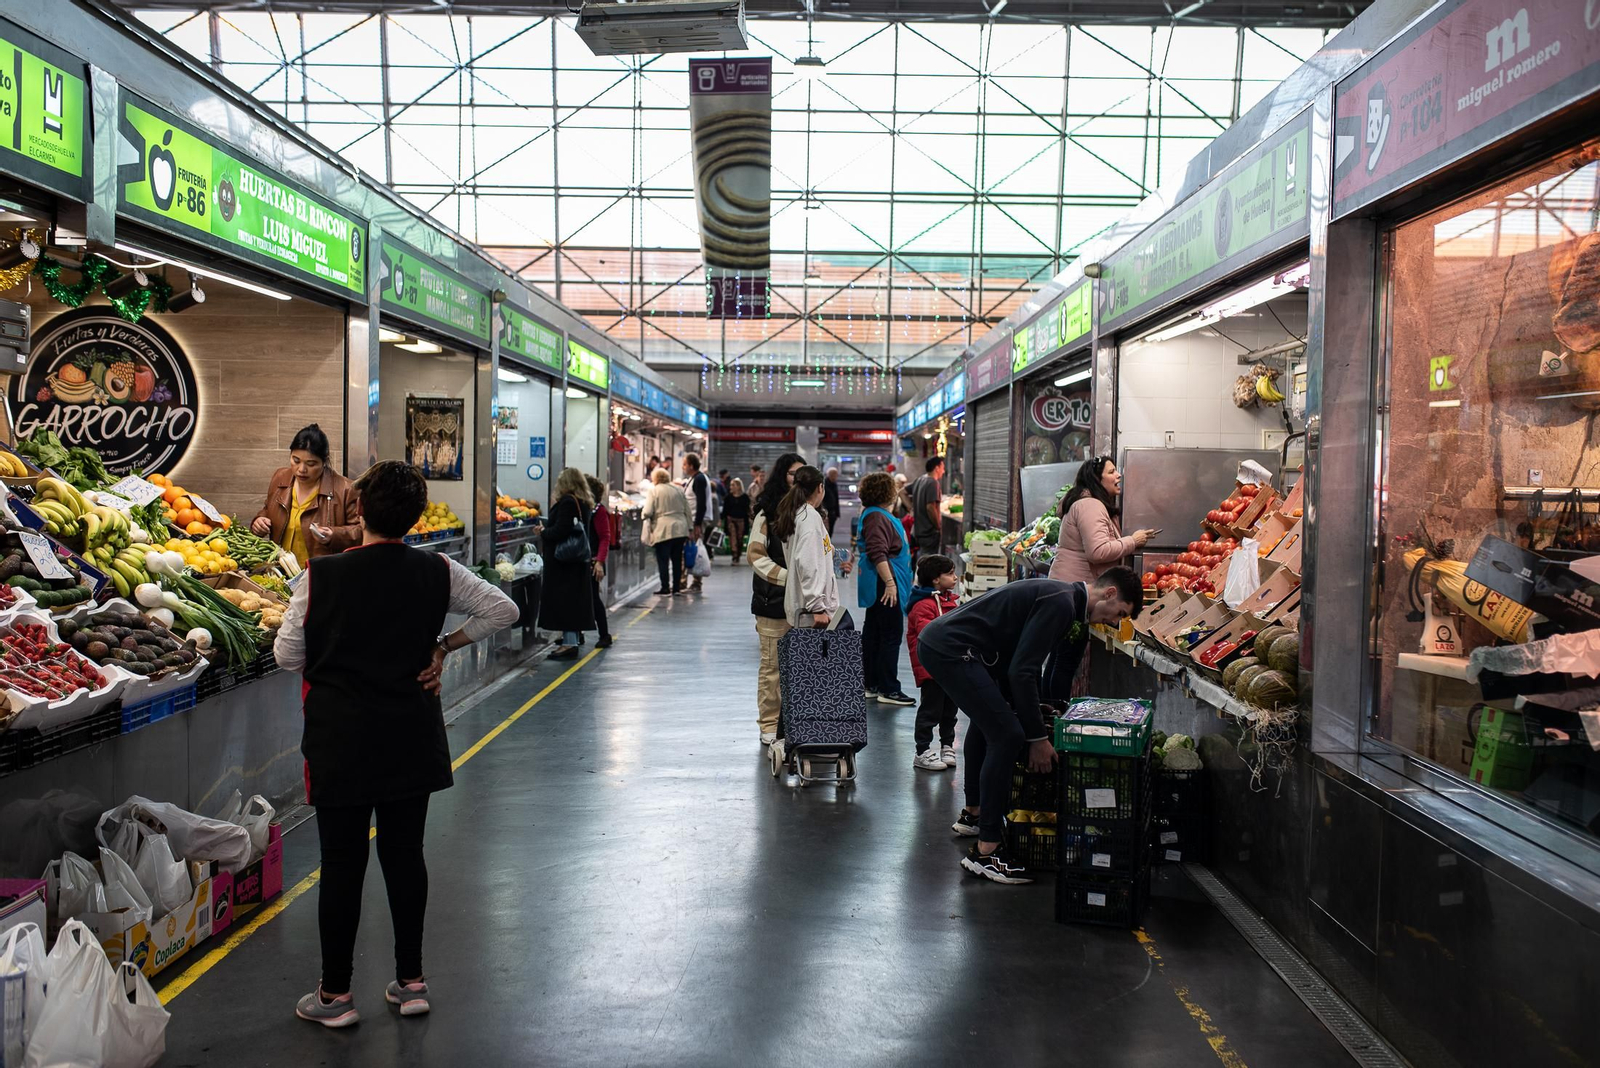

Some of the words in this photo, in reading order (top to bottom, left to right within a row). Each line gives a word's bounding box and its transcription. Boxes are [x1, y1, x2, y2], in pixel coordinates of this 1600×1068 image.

[1457, 70, 1504, 112] miguel
[1507, 40, 1561, 82] romero
[178, 166, 207, 190] FRUTERÍA
[239, 167, 295, 217] HUERTAS
[296, 197, 308, 224] EL
[309, 212, 348, 242] RINCON
[262, 216, 290, 248] LUIS
[291, 228, 329, 265] MIGUEL
[53, 327, 94, 356] Frutas
[97, 327, 106, 339] y
[109, 325, 160, 363] Verduras
[15, 402, 195, 445] GARROCHO
[1435, 643, 1455, 651] LAZO
[154, 936, 186, 970] Coplaca
